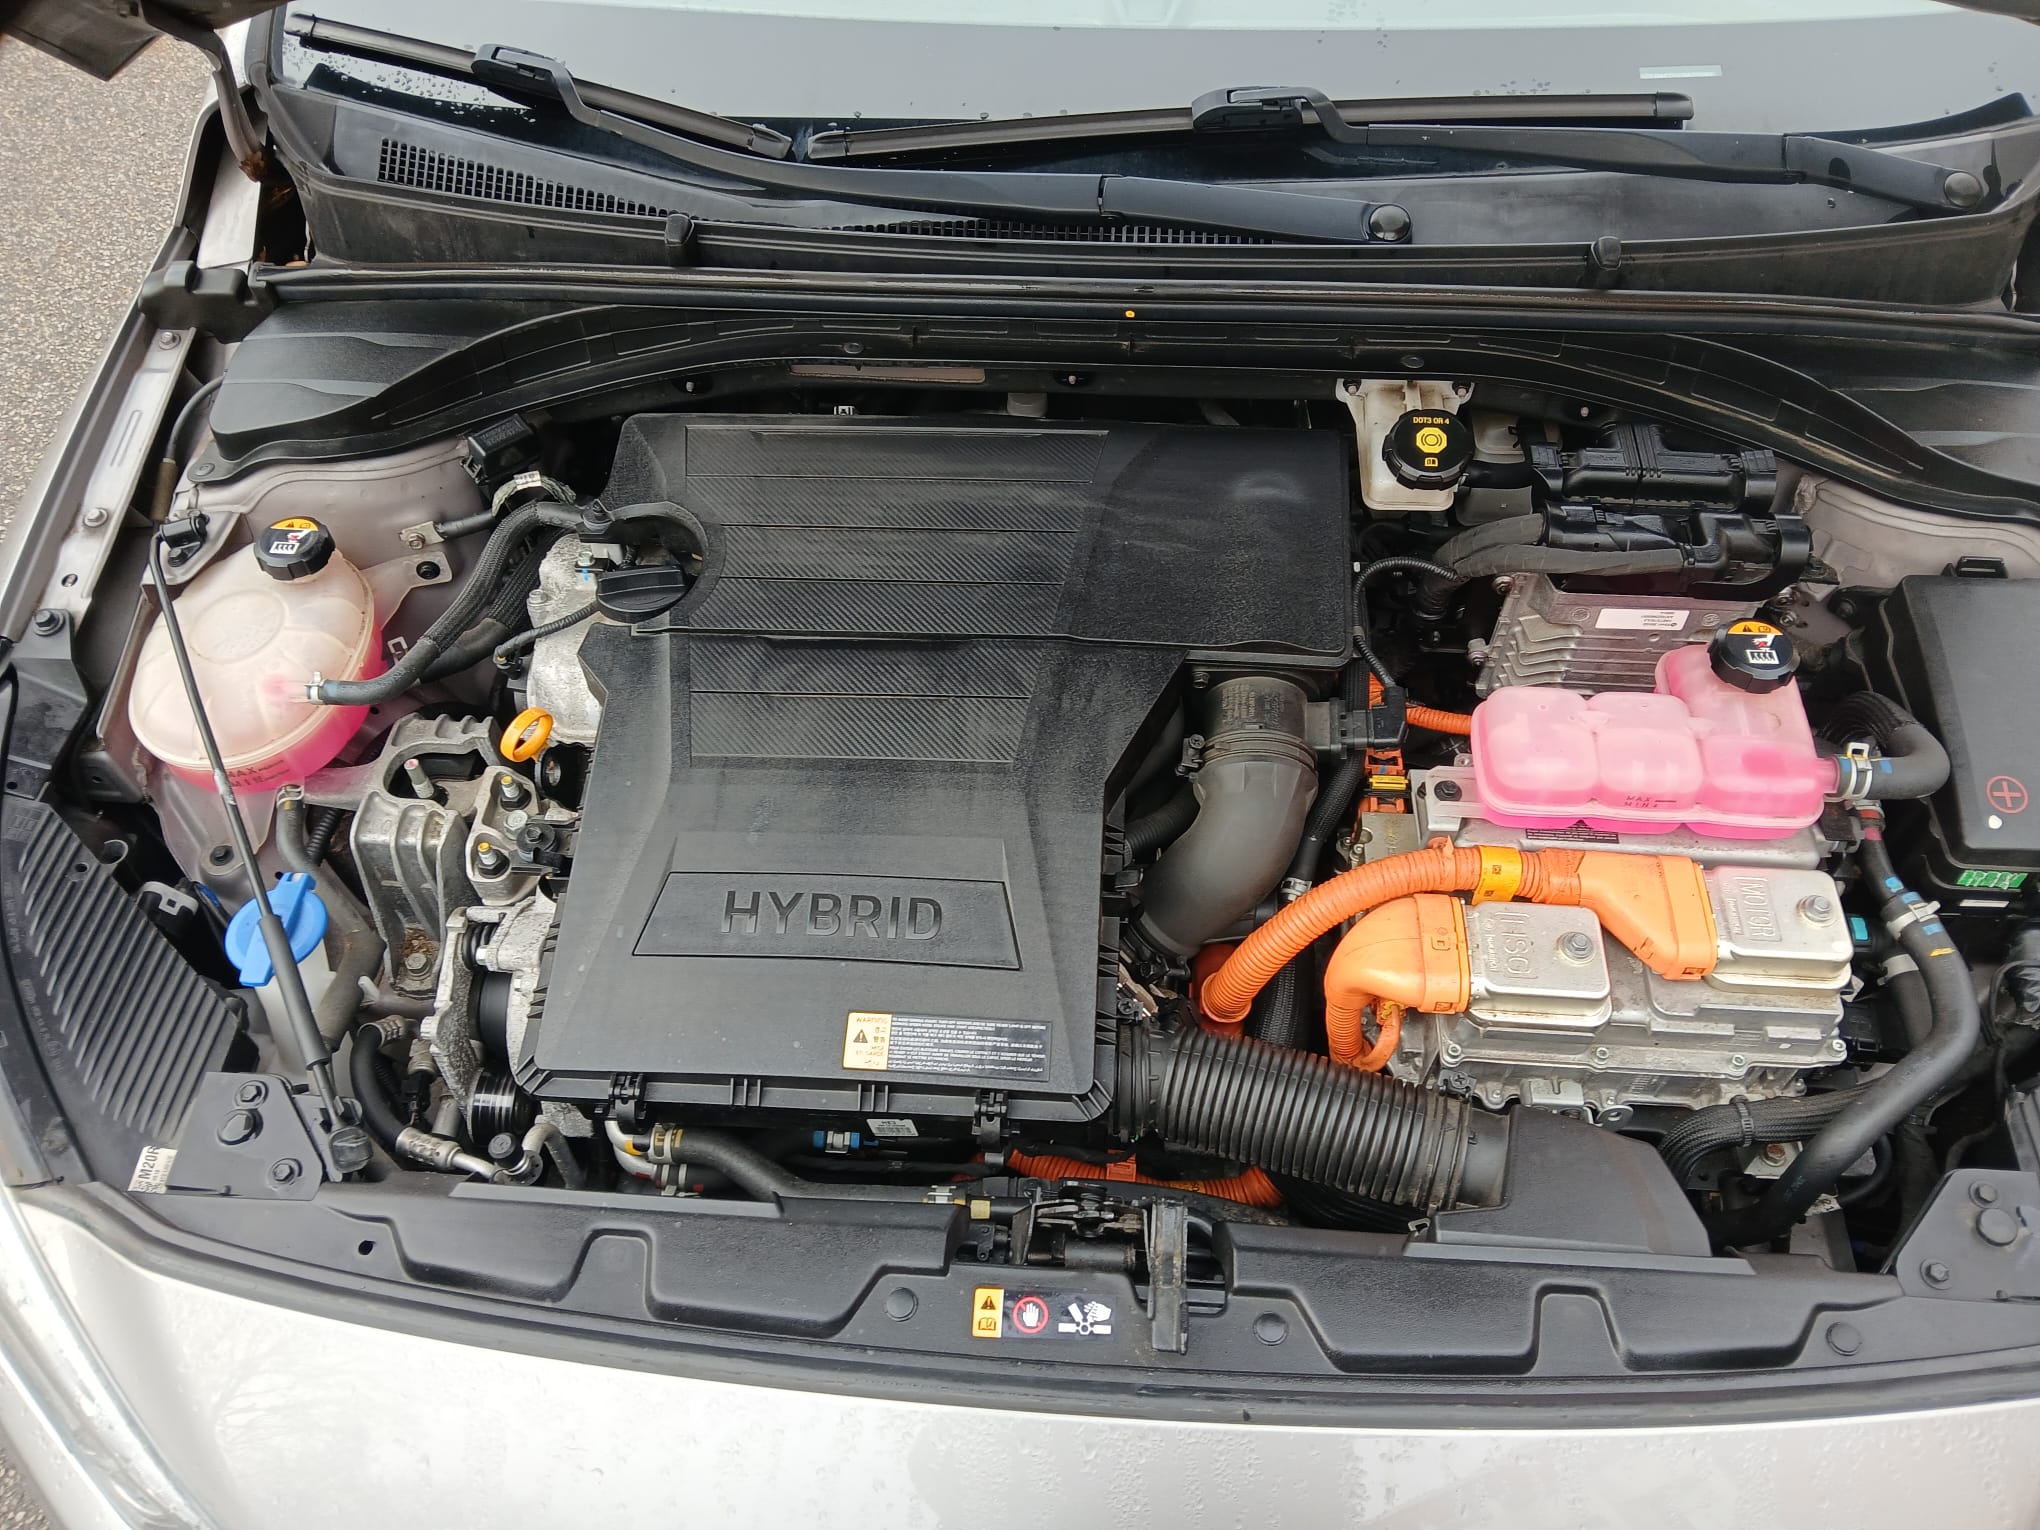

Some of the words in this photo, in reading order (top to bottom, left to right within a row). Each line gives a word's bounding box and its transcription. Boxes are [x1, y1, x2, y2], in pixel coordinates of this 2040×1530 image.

[1413, 416, 1432, 424] DOT3
[1433, 417, 1444, 425] OR
[720, 891, 942, 940] HYBRID
[1740, 882, 1776, 937] MOTOR
